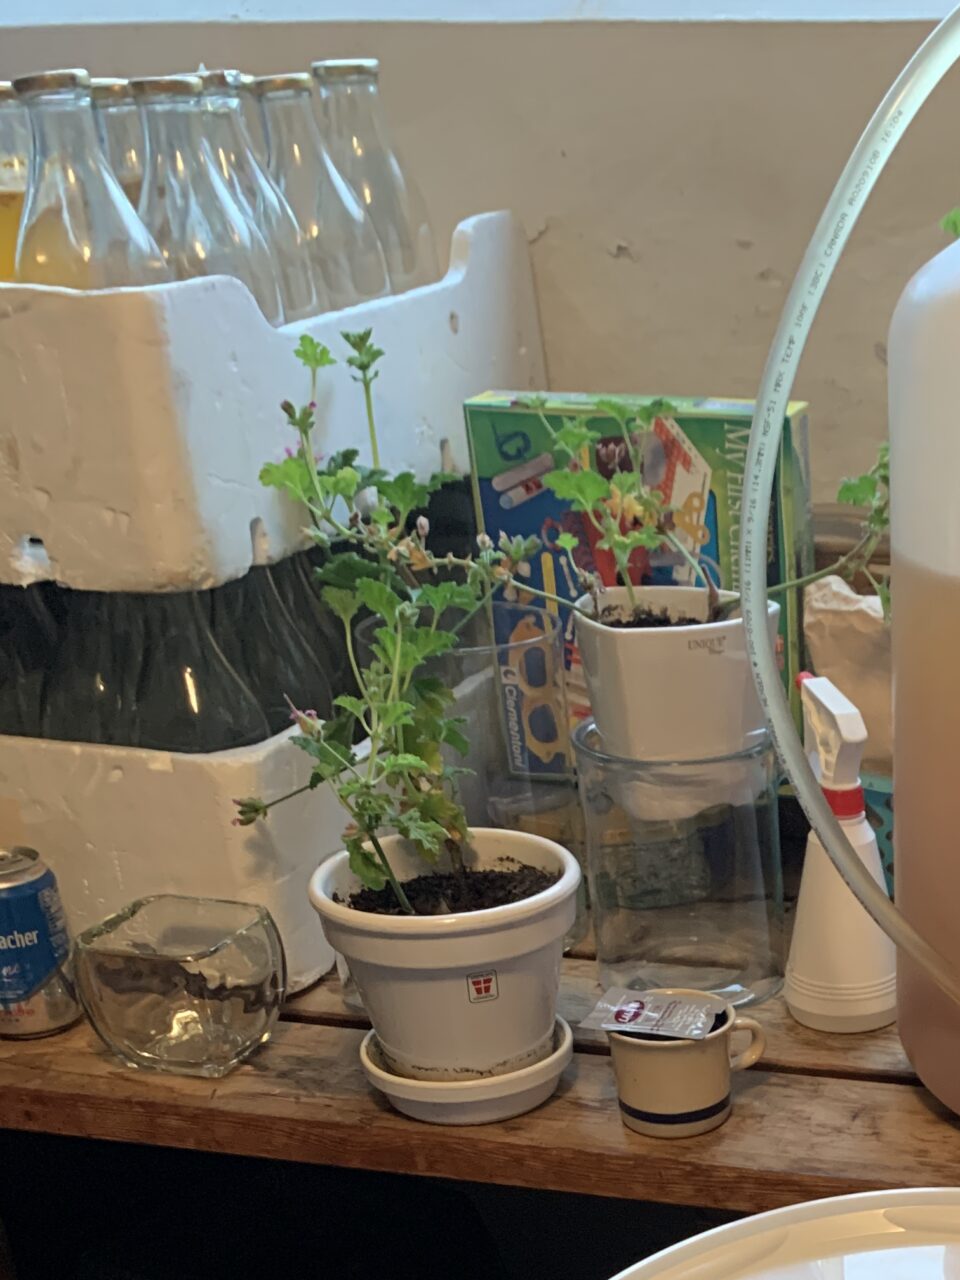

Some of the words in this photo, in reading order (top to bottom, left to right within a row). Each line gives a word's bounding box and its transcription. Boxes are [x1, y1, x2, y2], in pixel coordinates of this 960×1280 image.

[779, 333, 799, 364] TEMP
[822, 210, 849, 258] CANADA
[504, 685, 525, 767] Clementoni
[0, 929, 39, 950] acher
